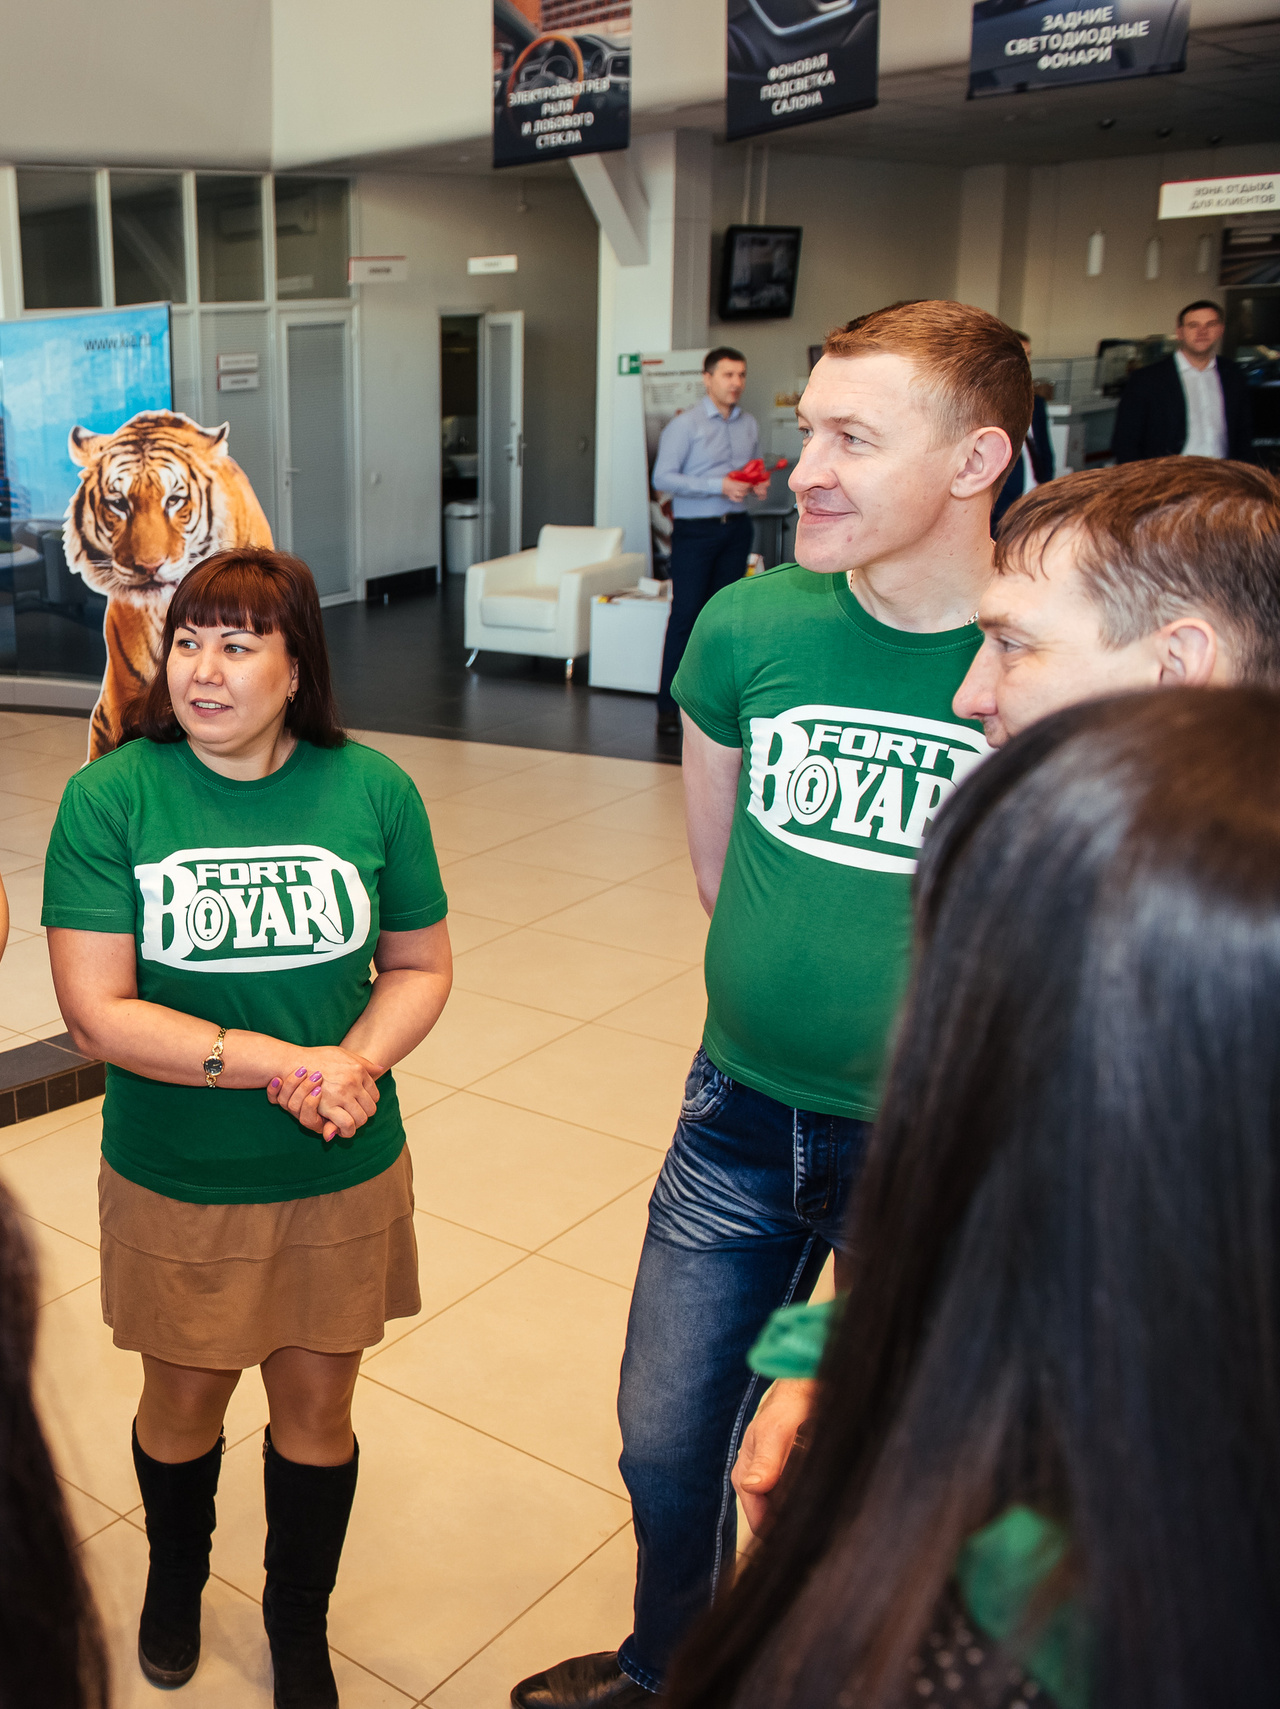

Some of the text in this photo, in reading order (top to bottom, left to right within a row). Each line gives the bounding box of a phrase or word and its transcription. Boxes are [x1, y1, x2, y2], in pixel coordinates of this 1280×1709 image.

[1041, 5, 1114, 32] ЗАДНИЕ
[1005, 20, 1150, 56] СВЕТОДИОДНЫЕ
[767, 53, 828, 81] ФОНОВАЯ
[1037, 45, 1112, 70] ФОНАРИ
[508, 79, 610, 107] ЭЛЕКТРООБОГРЕВ
[760, 70, 836, 101] ПОДСВЕТКА
[541, 99, 574, 117] РУЛЯ
[771, 90, 823, 115] САЛОНА
[521, 112, 594, 136] И ЛОБОВОГО
[536, 130, 582, 149] СТЕКЛА
[1194, 181, 1274, 197] ЗОНА ОТДЫХА
[1190, 194, 1276, 211] ДЛЯ КЛИЕНТОВ
[809, 723, 949, 770] FORT
[747, 717, 982, 849] BOYAR
[196, 860, 302, 886] FORT
[134, 860, 371, 962] BOYARD
